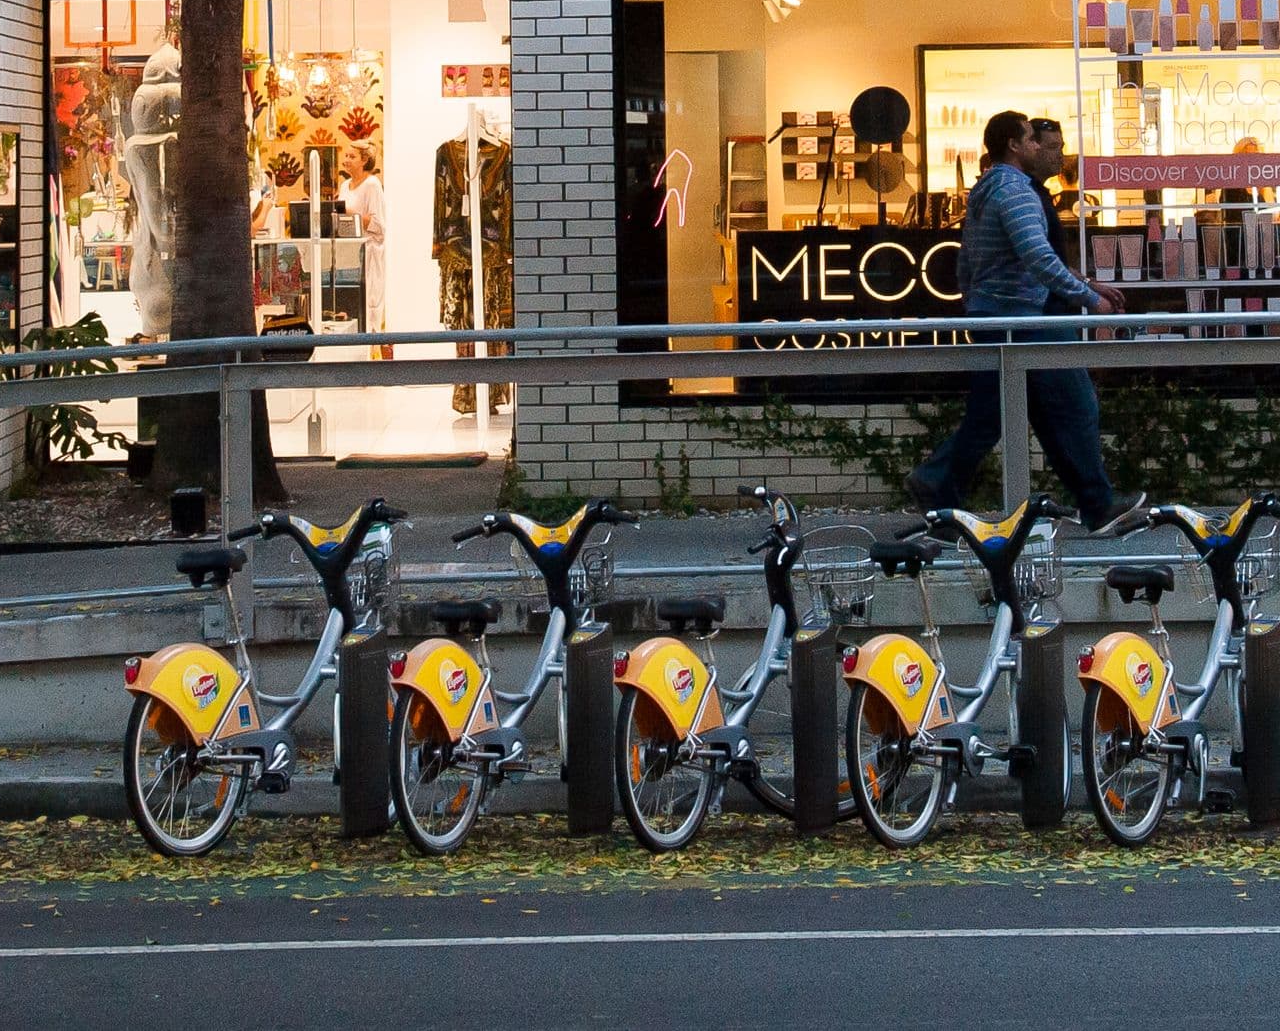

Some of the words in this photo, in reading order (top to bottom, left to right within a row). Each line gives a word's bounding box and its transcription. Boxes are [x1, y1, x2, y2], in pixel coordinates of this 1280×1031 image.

[1098, 162, 1188, 183] Discover
[1195, 165, 1241, 188] your
[752, 241, 963, 301] MECC
